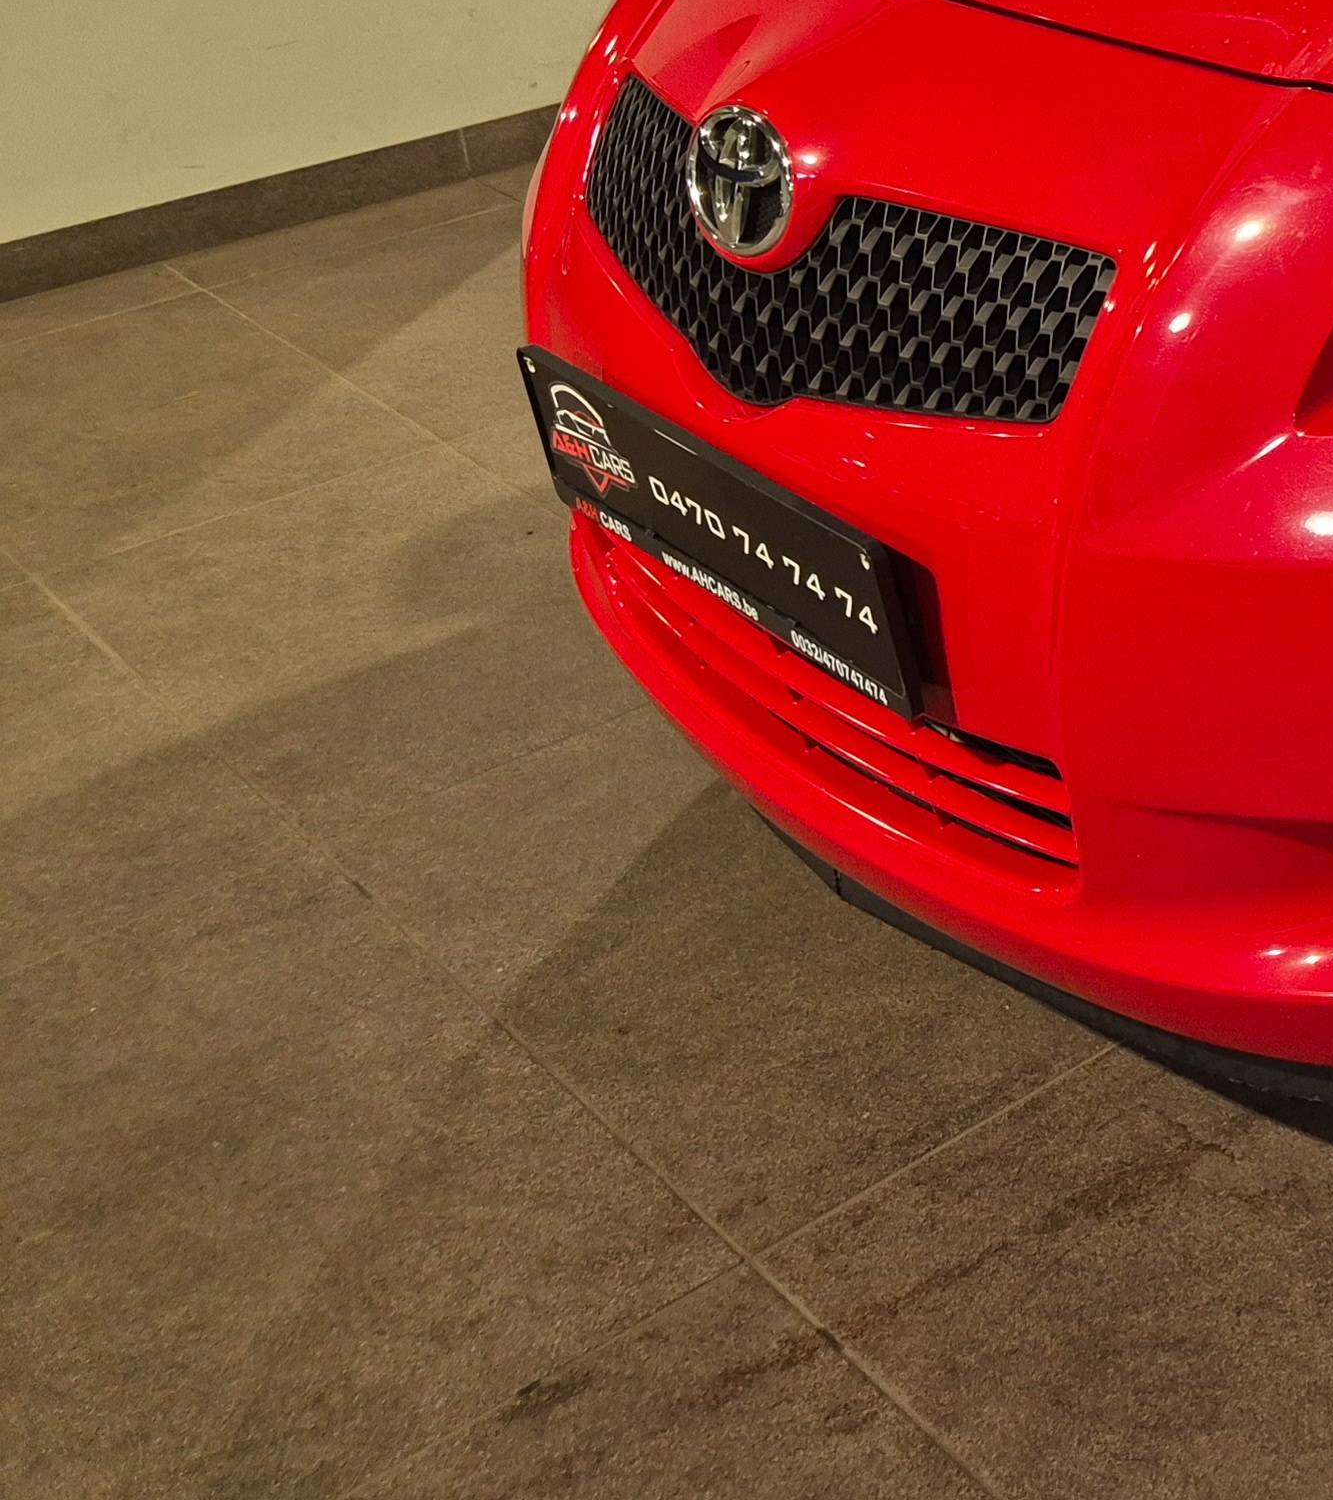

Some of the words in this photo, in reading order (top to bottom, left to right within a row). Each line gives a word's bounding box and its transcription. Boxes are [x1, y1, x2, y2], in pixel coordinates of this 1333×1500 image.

[576, 496, 600, 521] A&H
[600, 511, 632, 542] CARS
[649, 476, 726, 540] 0470
[732, 525, 774, 569] 74
[782, 555, 826, 601] 74
[834, 586, 878, 634] 74
[661, 551, 759, 621] www.AHCARS.be
